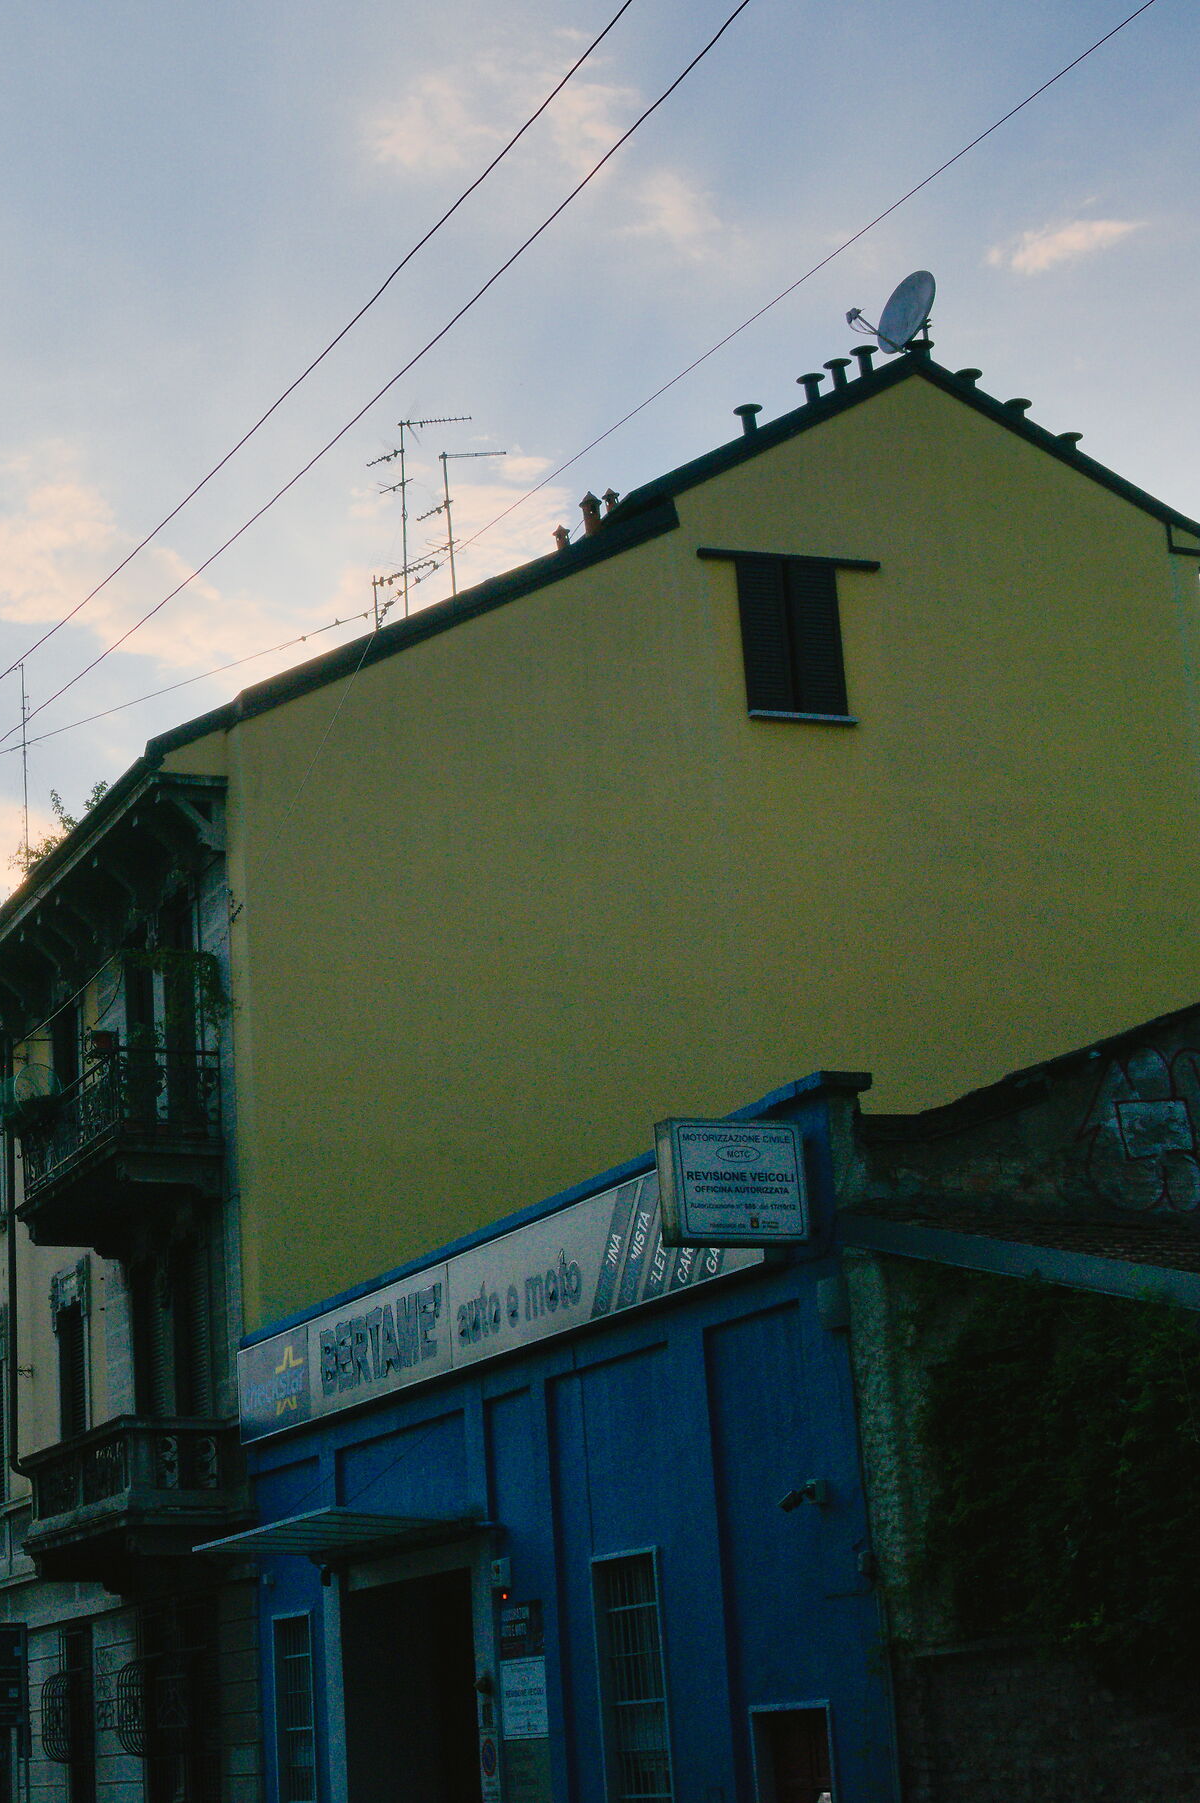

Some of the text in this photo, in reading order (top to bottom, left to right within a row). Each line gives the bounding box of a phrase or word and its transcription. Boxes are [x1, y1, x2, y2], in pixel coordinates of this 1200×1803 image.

[682, 1133, 791, 1144] MOTORIZZAZIONE CIVILE
[726, 1150, 751, 1158] MCTC
[686, 1171, 795, 1183] REVISIONE VEICOLI
[694, 1185, 790, 1194] OFFICINA AUTORIZZATA
[457, 1249, 582, 1348] auto e moto
